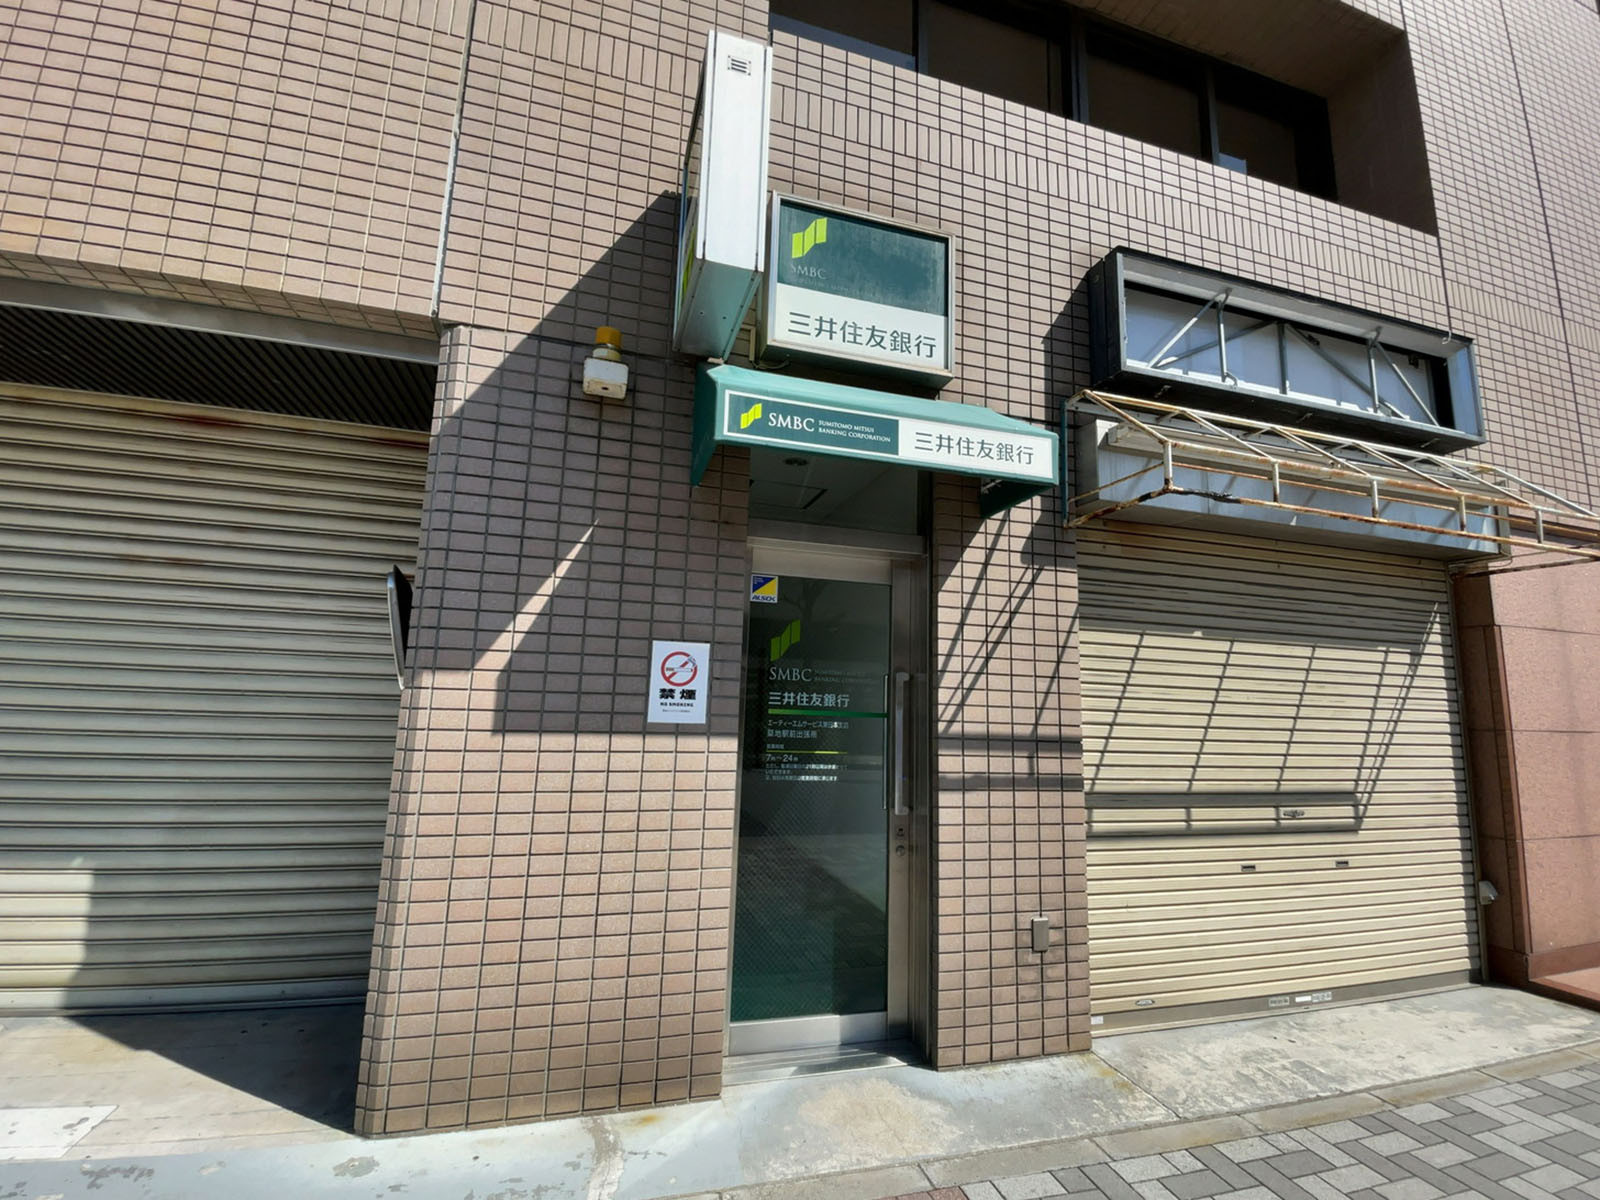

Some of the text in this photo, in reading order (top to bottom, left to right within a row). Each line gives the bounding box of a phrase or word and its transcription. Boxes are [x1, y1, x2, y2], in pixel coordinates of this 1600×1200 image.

[789, 264, 828, 280] SMBC
[788, 312, 937, 358] 三井住友銀行
[768, 412, 815, 432] SMBC
[818, 419, 875, 433] SUMITOMO MITSUI
[818, 427, 891, 443] BANKING CORPORATION
[914, 432, 1034, 465] 三井住友銀行
[769, 667, 812, 681] SMBC
[659, 688, 697, 700] 禁煙
[768, 691, 850, 707] 三井住友銀行
